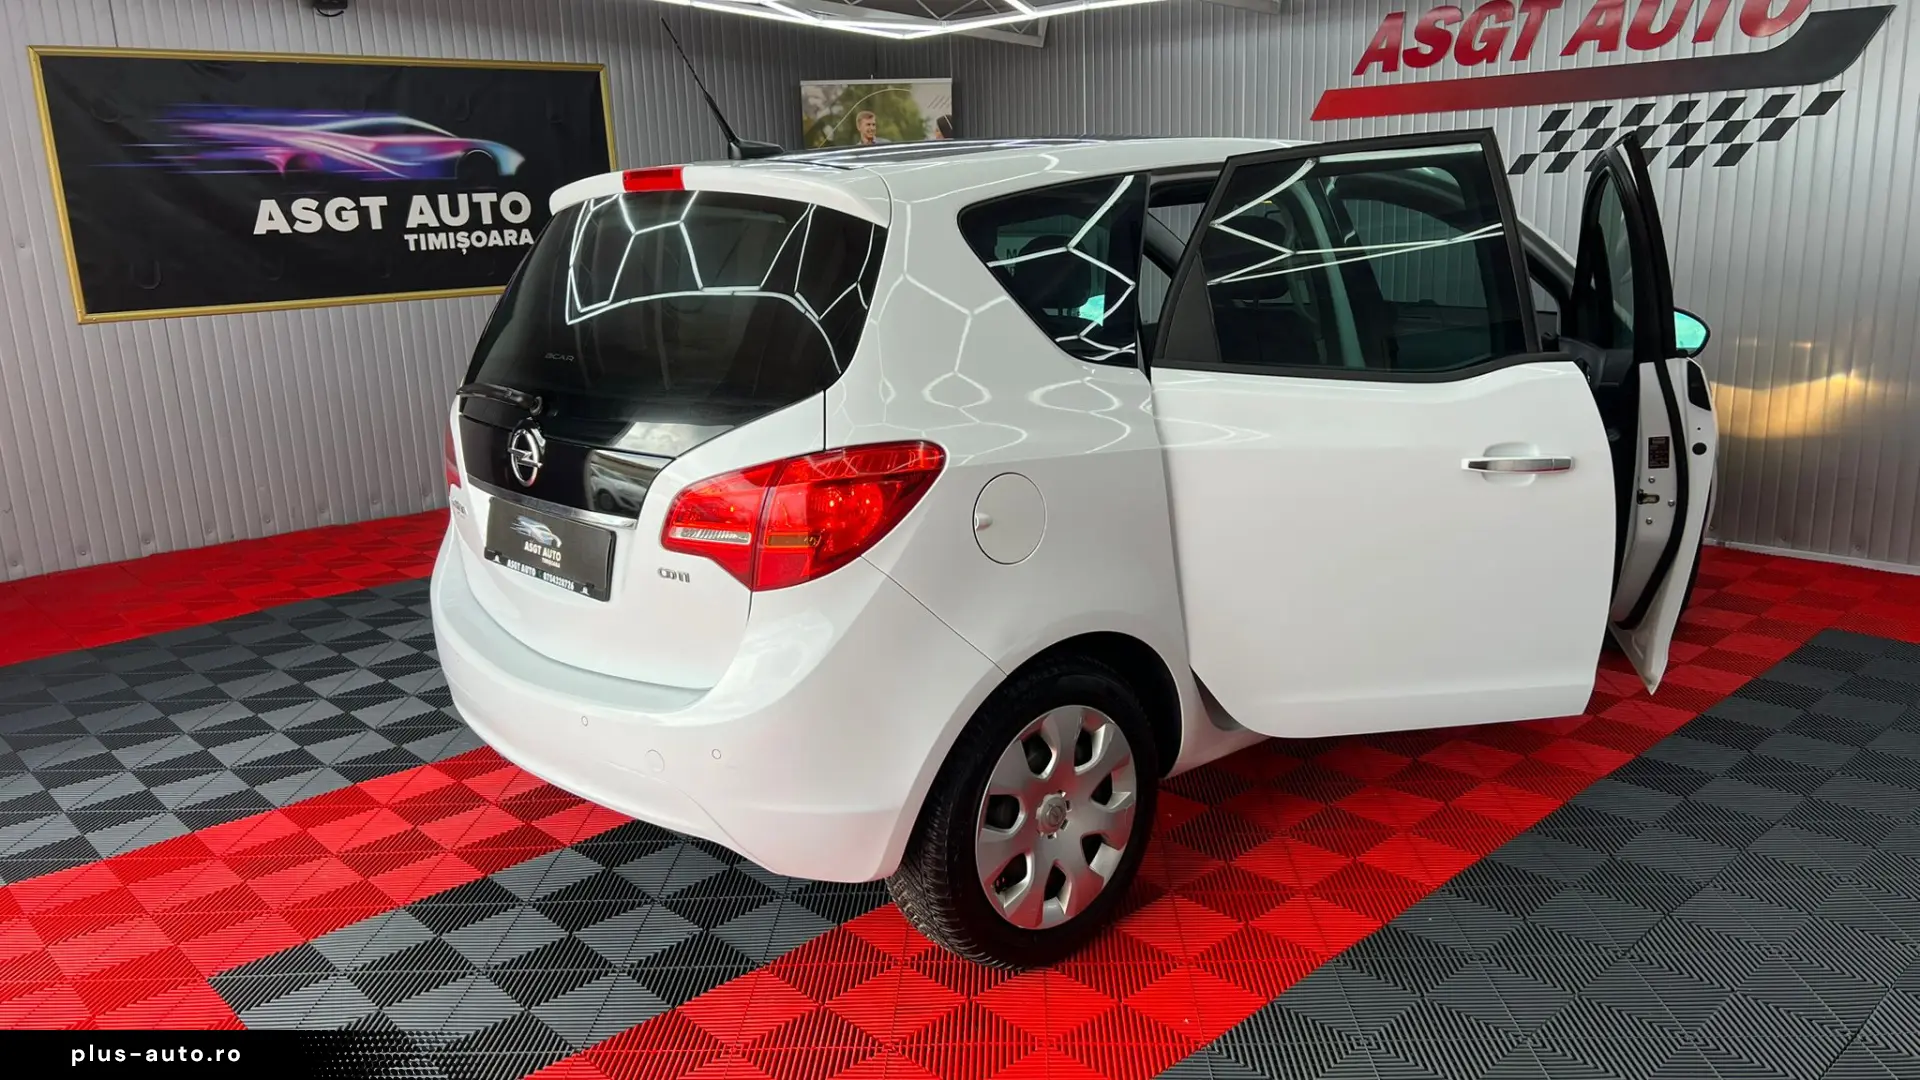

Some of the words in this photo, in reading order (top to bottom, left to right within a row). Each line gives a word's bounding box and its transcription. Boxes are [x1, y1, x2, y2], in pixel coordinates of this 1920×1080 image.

[1352, 0, 1563, 76] ASGT
[253, 196, 388, 235] ASGT
[405, 191, 532, 228] AUTO
[404, 228, 535, 255] TIMIȘOARA
[524, 541, 541, 554] ASGT
[542, 547, 562, 561] AUTO
[507, 559, 521, 571] ASGT
[520, 563, 536, 576] AUTO
